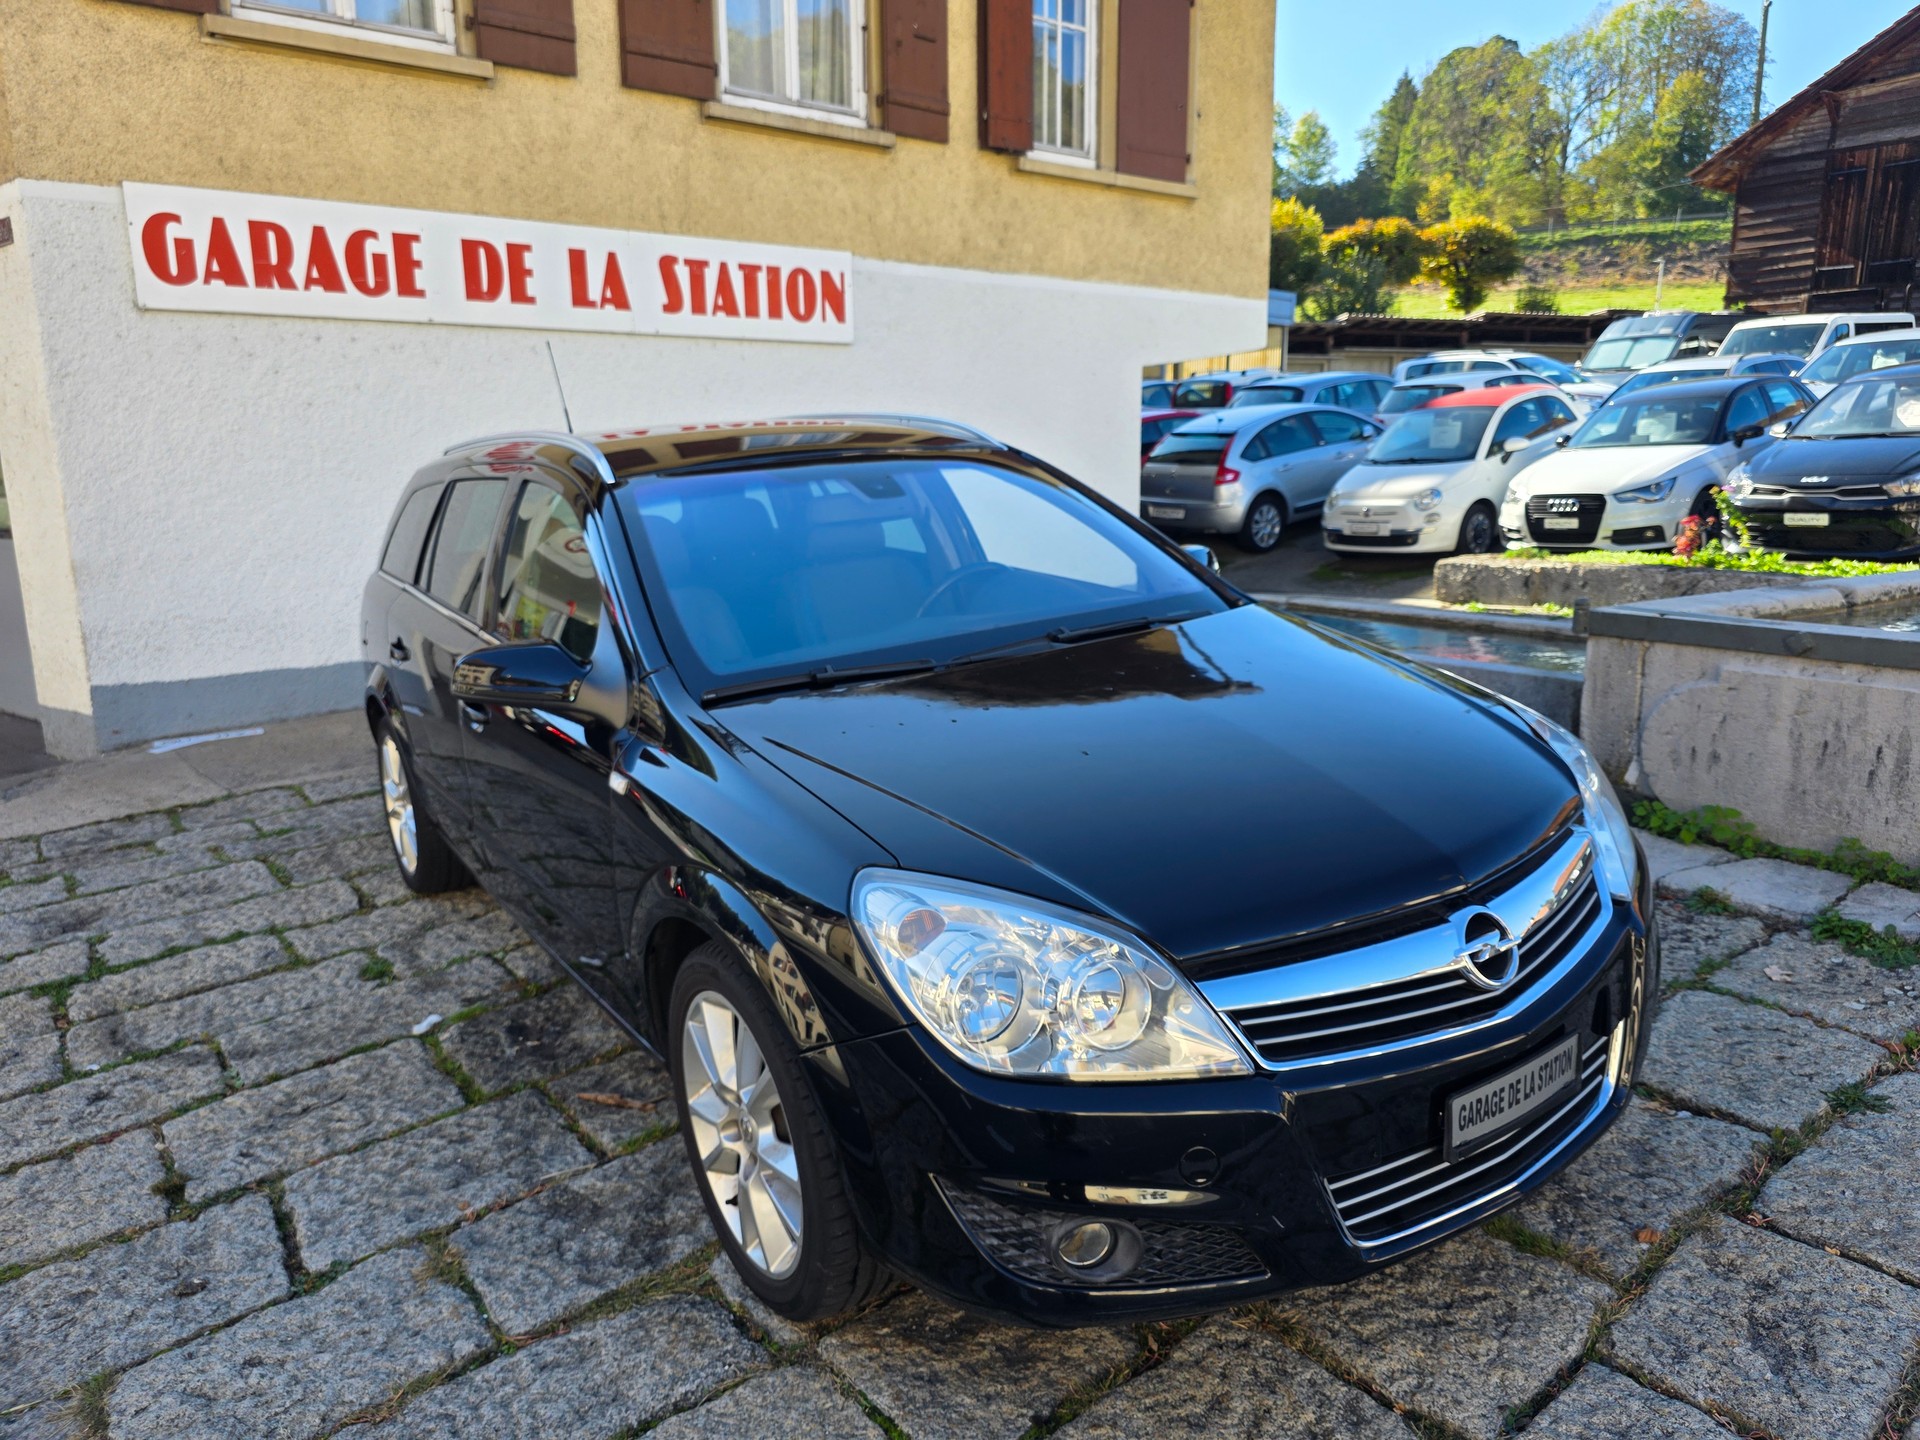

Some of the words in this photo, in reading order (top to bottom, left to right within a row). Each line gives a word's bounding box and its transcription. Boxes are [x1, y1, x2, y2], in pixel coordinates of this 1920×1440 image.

[141, 212, 426, 298] GARAGE
[461, 239, 537, 304] DE
[568, 248, 631, 311] LA
[658, 255, 847, 324] STATION
[1458, 1086, 1505, 1132] GARAGE
[1507, 1078, 1522, 1110] DE
[1523, 1070, 1536, 1101] LA
[1538, 1045, 1574, 1092] STATION
